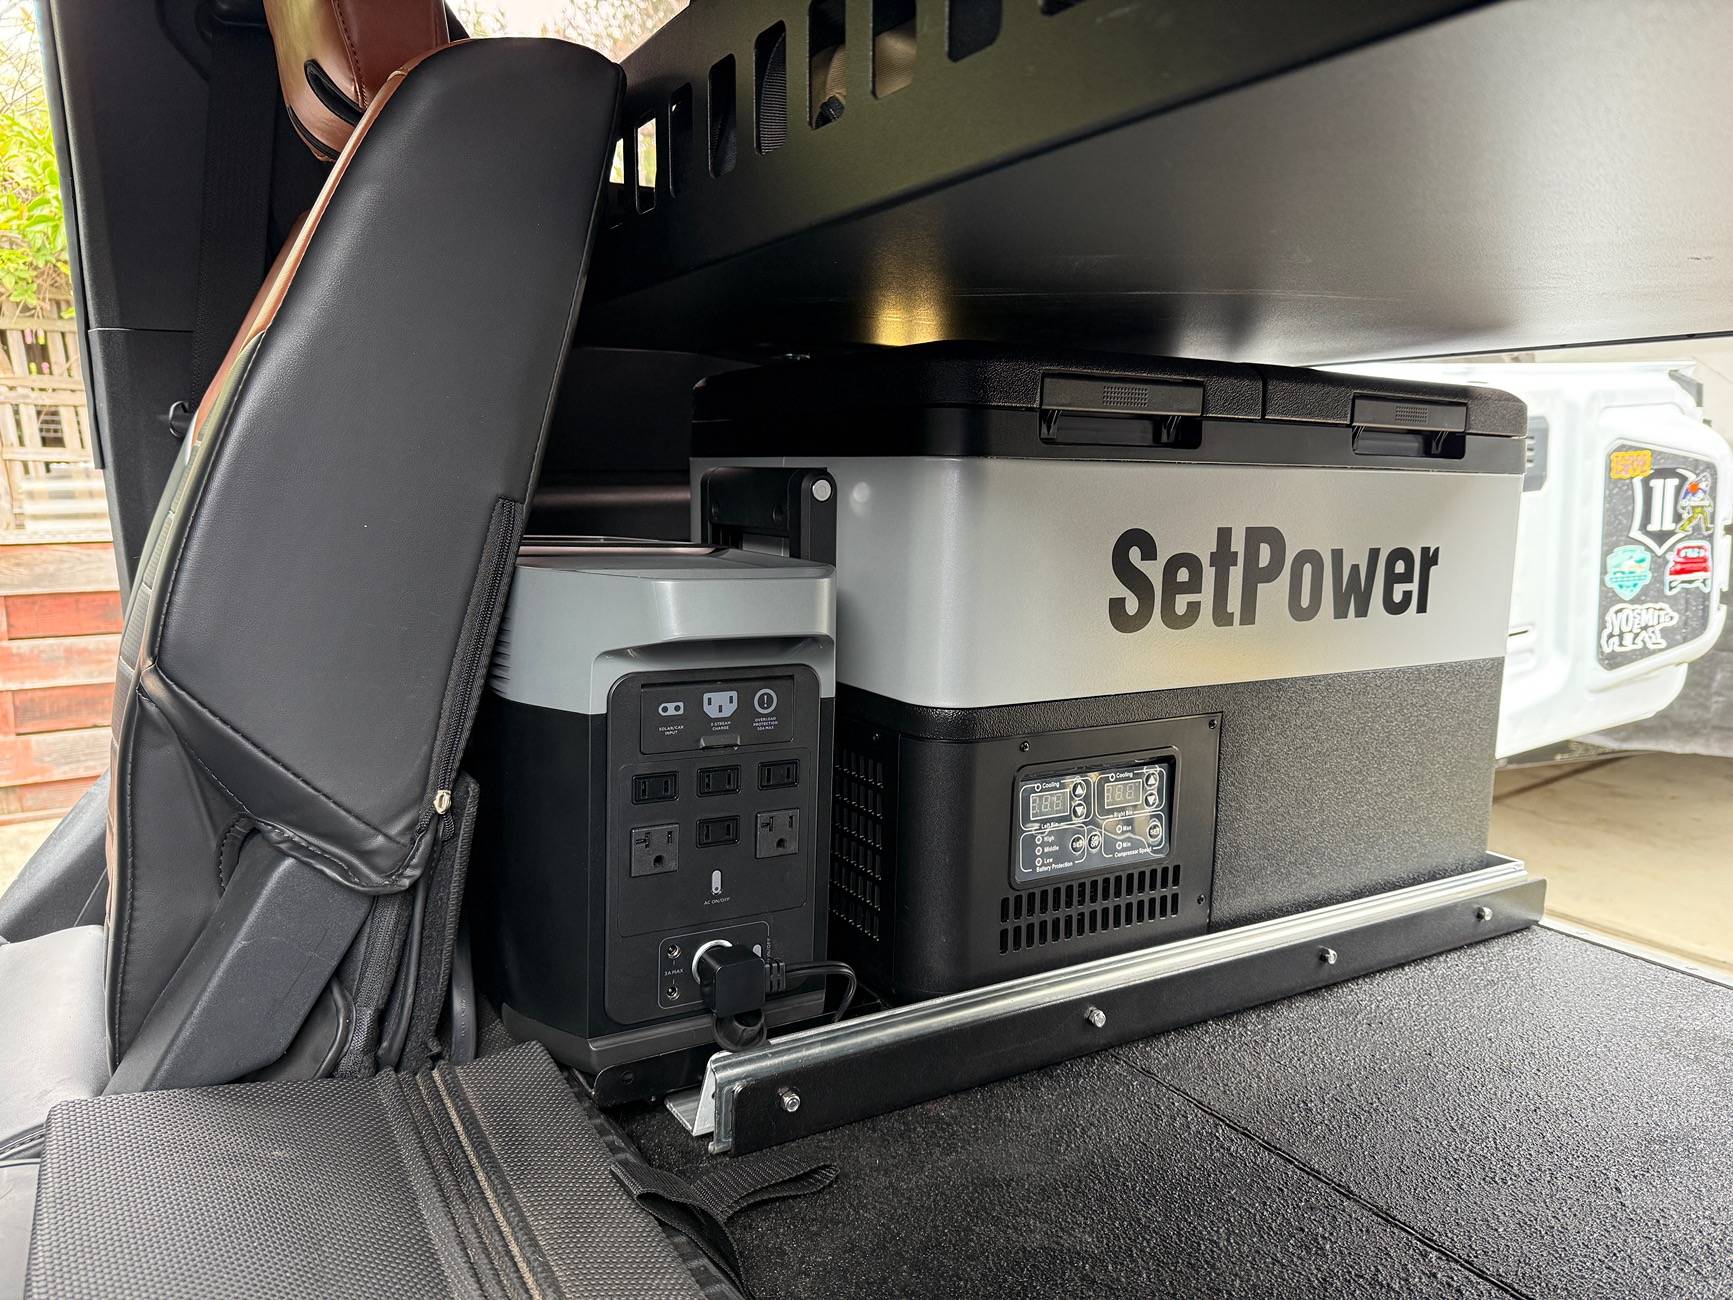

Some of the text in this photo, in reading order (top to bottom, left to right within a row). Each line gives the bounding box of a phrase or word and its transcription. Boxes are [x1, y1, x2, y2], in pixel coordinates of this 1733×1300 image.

[1108, 526, 1441, 634] SetPower
[1042, 781, 1060, 789] Cooling
[1043, 835, 1055, 843] High
[1114, 849, 1139, 858] Compressor
[1036, 861, 1073, 873] Battery Protection
